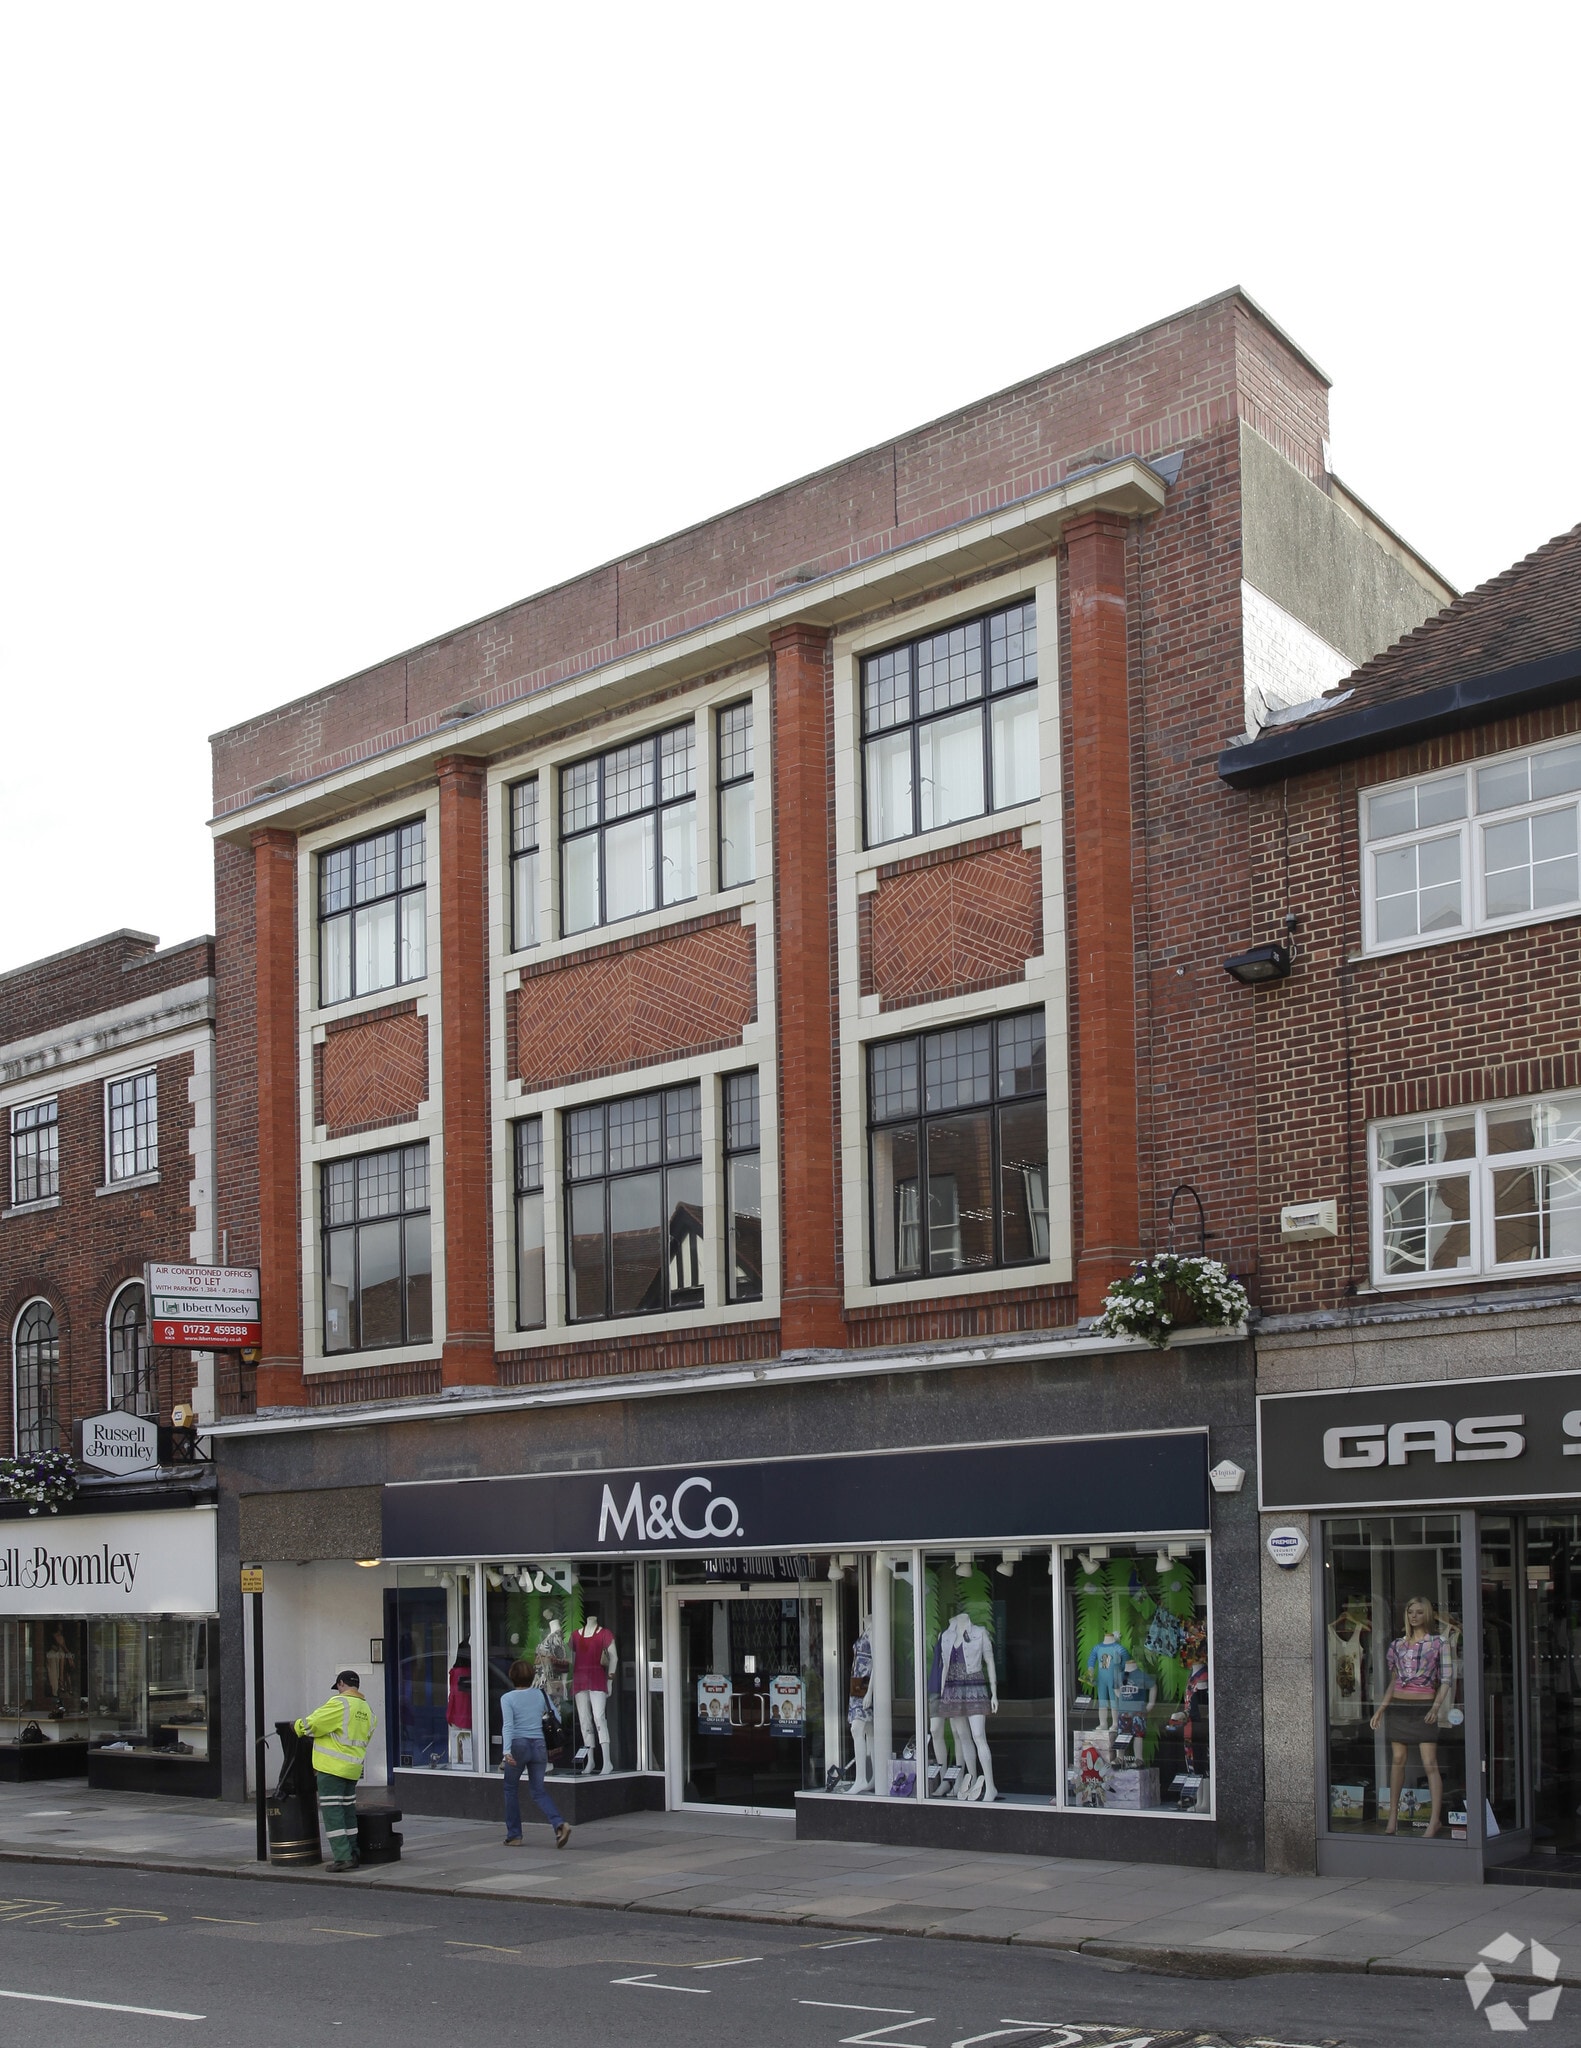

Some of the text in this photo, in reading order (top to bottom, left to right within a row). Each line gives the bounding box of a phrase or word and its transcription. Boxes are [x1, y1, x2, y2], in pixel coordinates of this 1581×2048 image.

[171, 1268, 222, 1277] CONDITIONED
[224, 1270, 253, 1278] OFFICES
[188, 1277, 221, 1286] TO LET
[182, 1303, 250, 1316] Ibbett Mosely
[182, 1325, 248, 1335] 01732 459388
[94, 1424, 145, 1442] Russell
[1323, 1413, 1525, 1469] GAS
[598, 1476, 745, 1542] M&Co.
[1271, 1538, 1298, 1546] PREMIER
